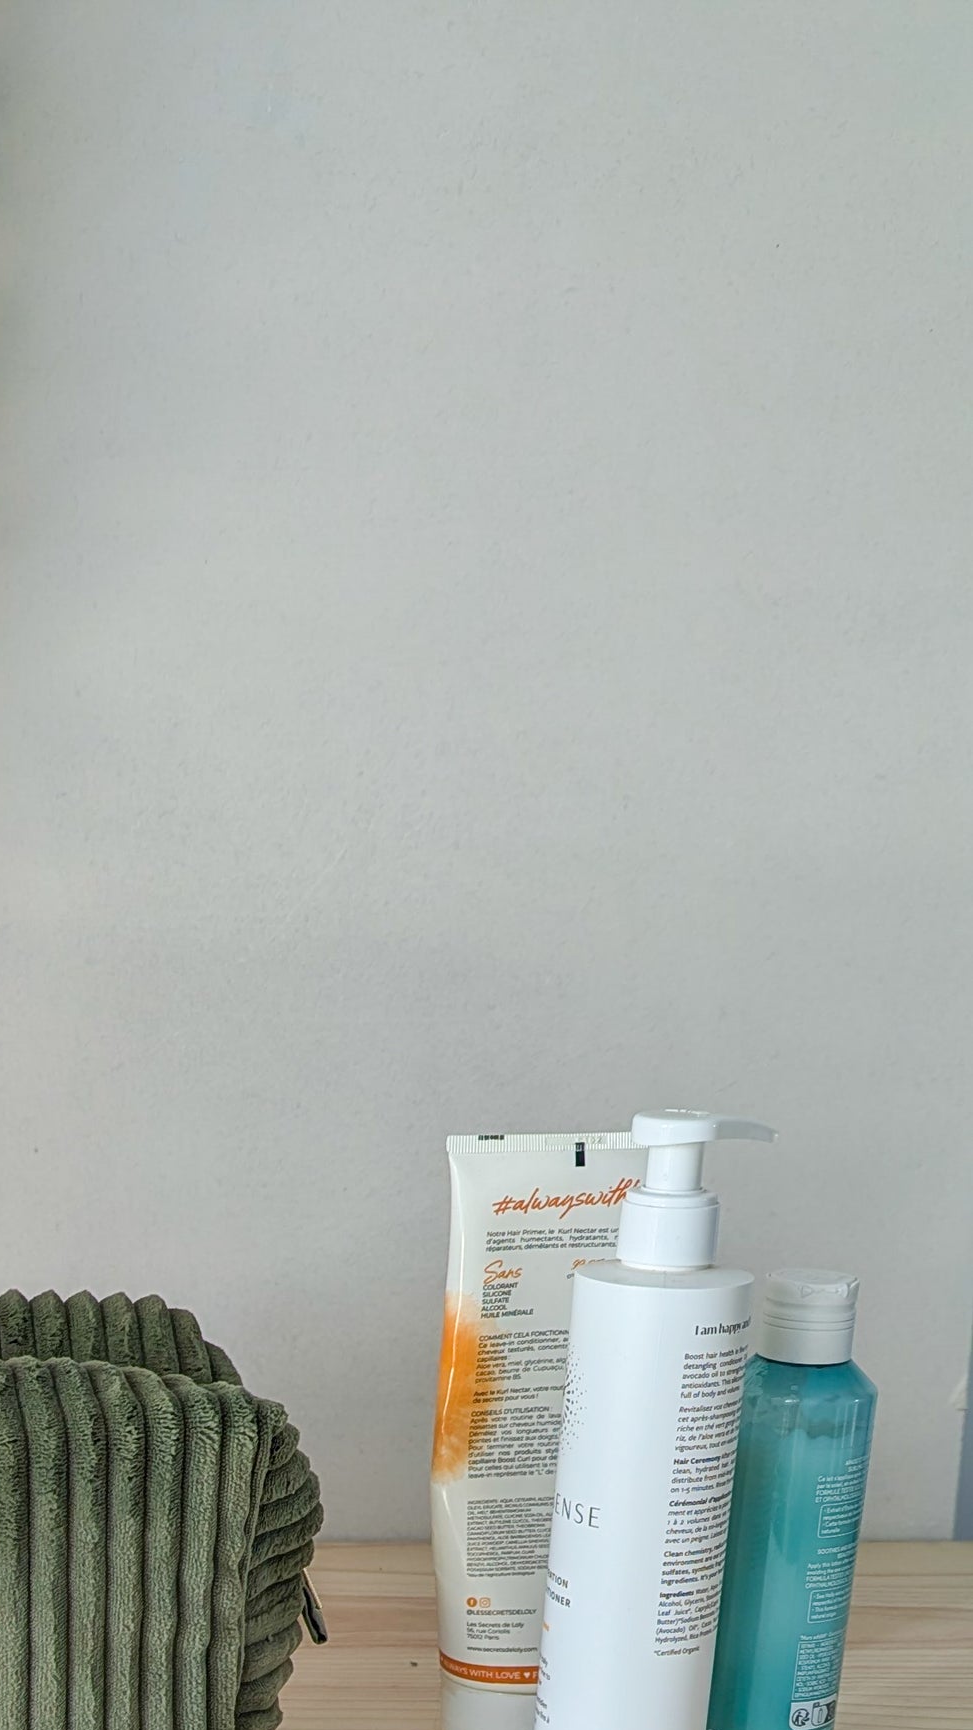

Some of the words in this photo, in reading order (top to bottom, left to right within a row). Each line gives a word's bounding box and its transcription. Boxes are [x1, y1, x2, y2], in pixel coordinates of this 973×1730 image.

[492, 1178, 640, 1219] #alwayswith
[484, 1260, 522, 1284] Sans
[483, 1282, 518, 1291] COLORANT
[483, 1290, 511, 1298] SILICONE
[482, 1297, 509, 1305] SULFATE
[695, 1325, 699, 1335] I
[700, 1327, 717, 1335] am
[479, 1333, 512, 1341] COMMENT
[701, 1390, 716, 1398] body
[471, 1409, 502, 1417] CONSEILS
[691, 1456, 721, 1464] Ceremony
[555, 1492, 600, 1528] ENSE
[660, 1590, 694, 1600] Ingredients
[469, 1670, 493, 1678] WITH
[496, 1671, 521, 1679] LOVE
